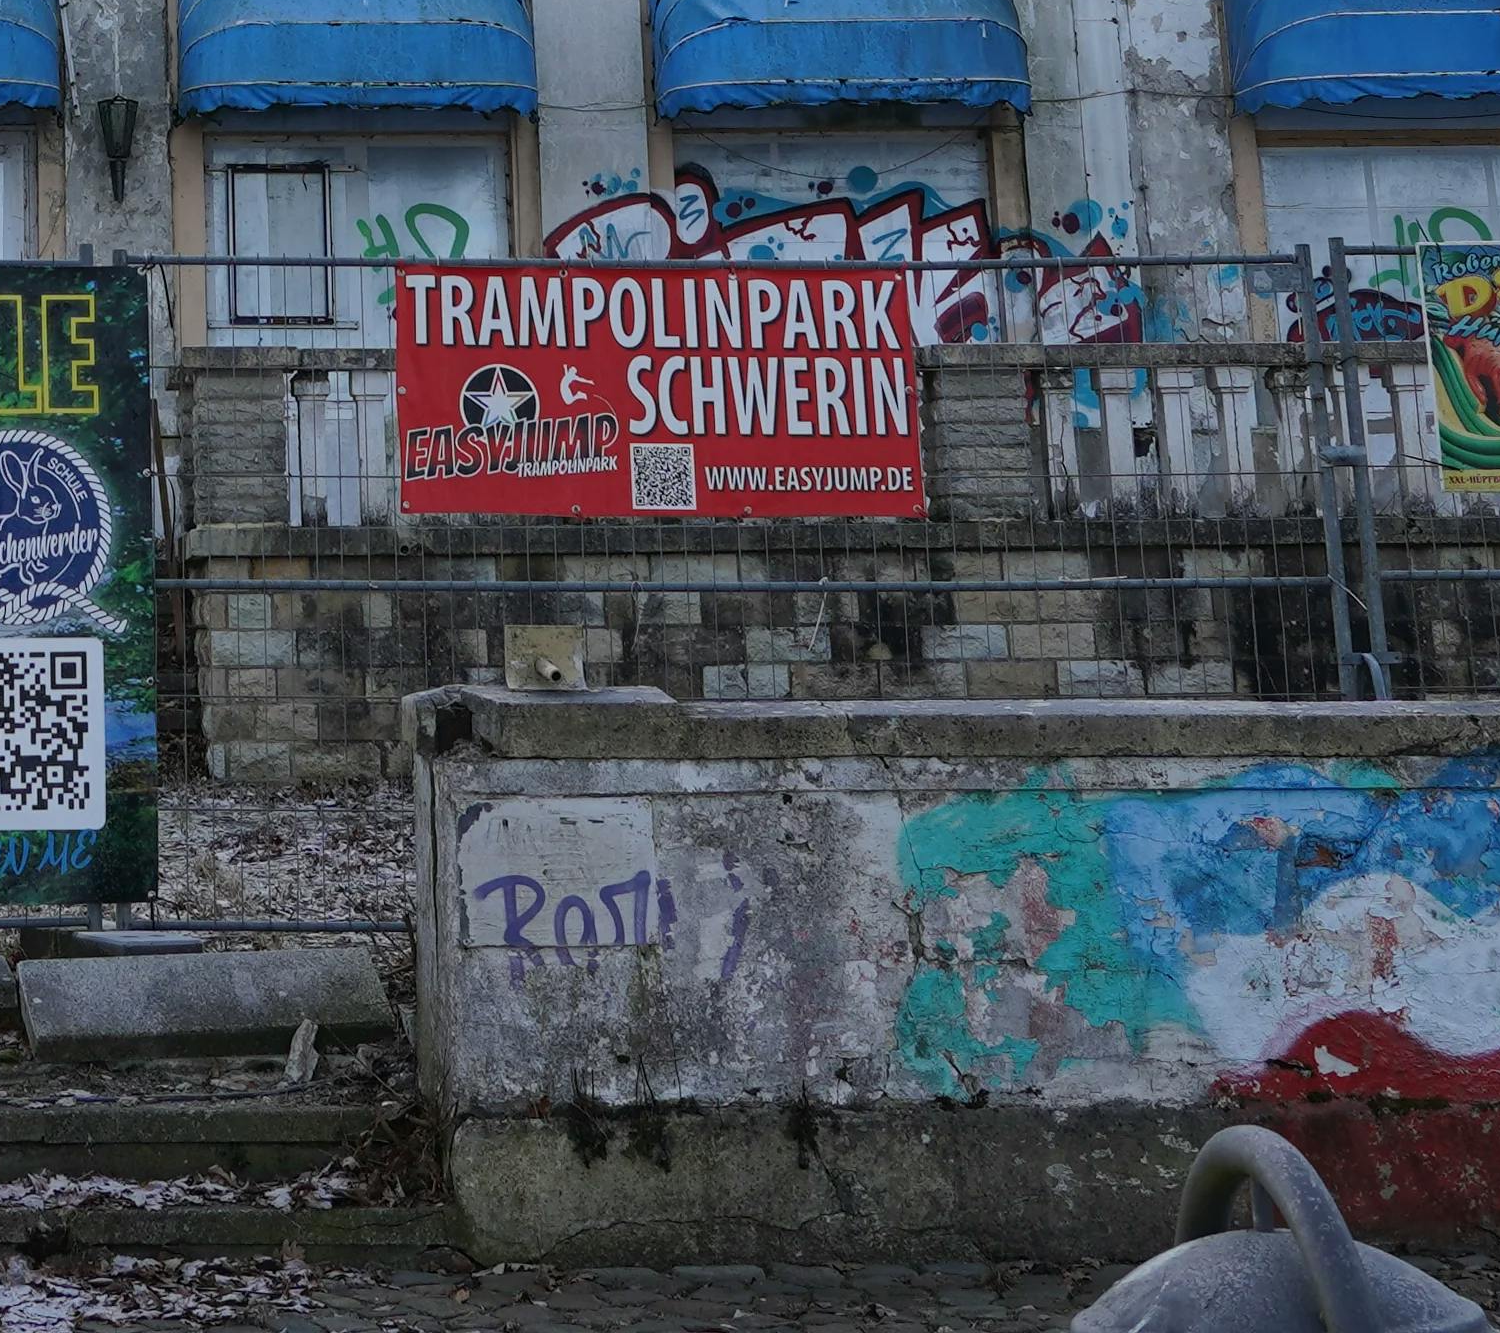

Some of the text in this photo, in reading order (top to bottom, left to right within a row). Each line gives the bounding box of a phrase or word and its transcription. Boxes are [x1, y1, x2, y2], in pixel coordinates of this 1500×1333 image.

[404, 274, 901, 351] TRAMPOLINPARK
[626, 355, 911, 437] SCHWERIN
[404, 412, 620, 482] EASYJUMP
[516, 454, 619, 479] TRAMPOLINPARK
[46, 456, 89, 503] SCHULE
[704, 464, 914, 493] WWW.EASYJUMP.DE
[36, 828, 97, 876] ME
